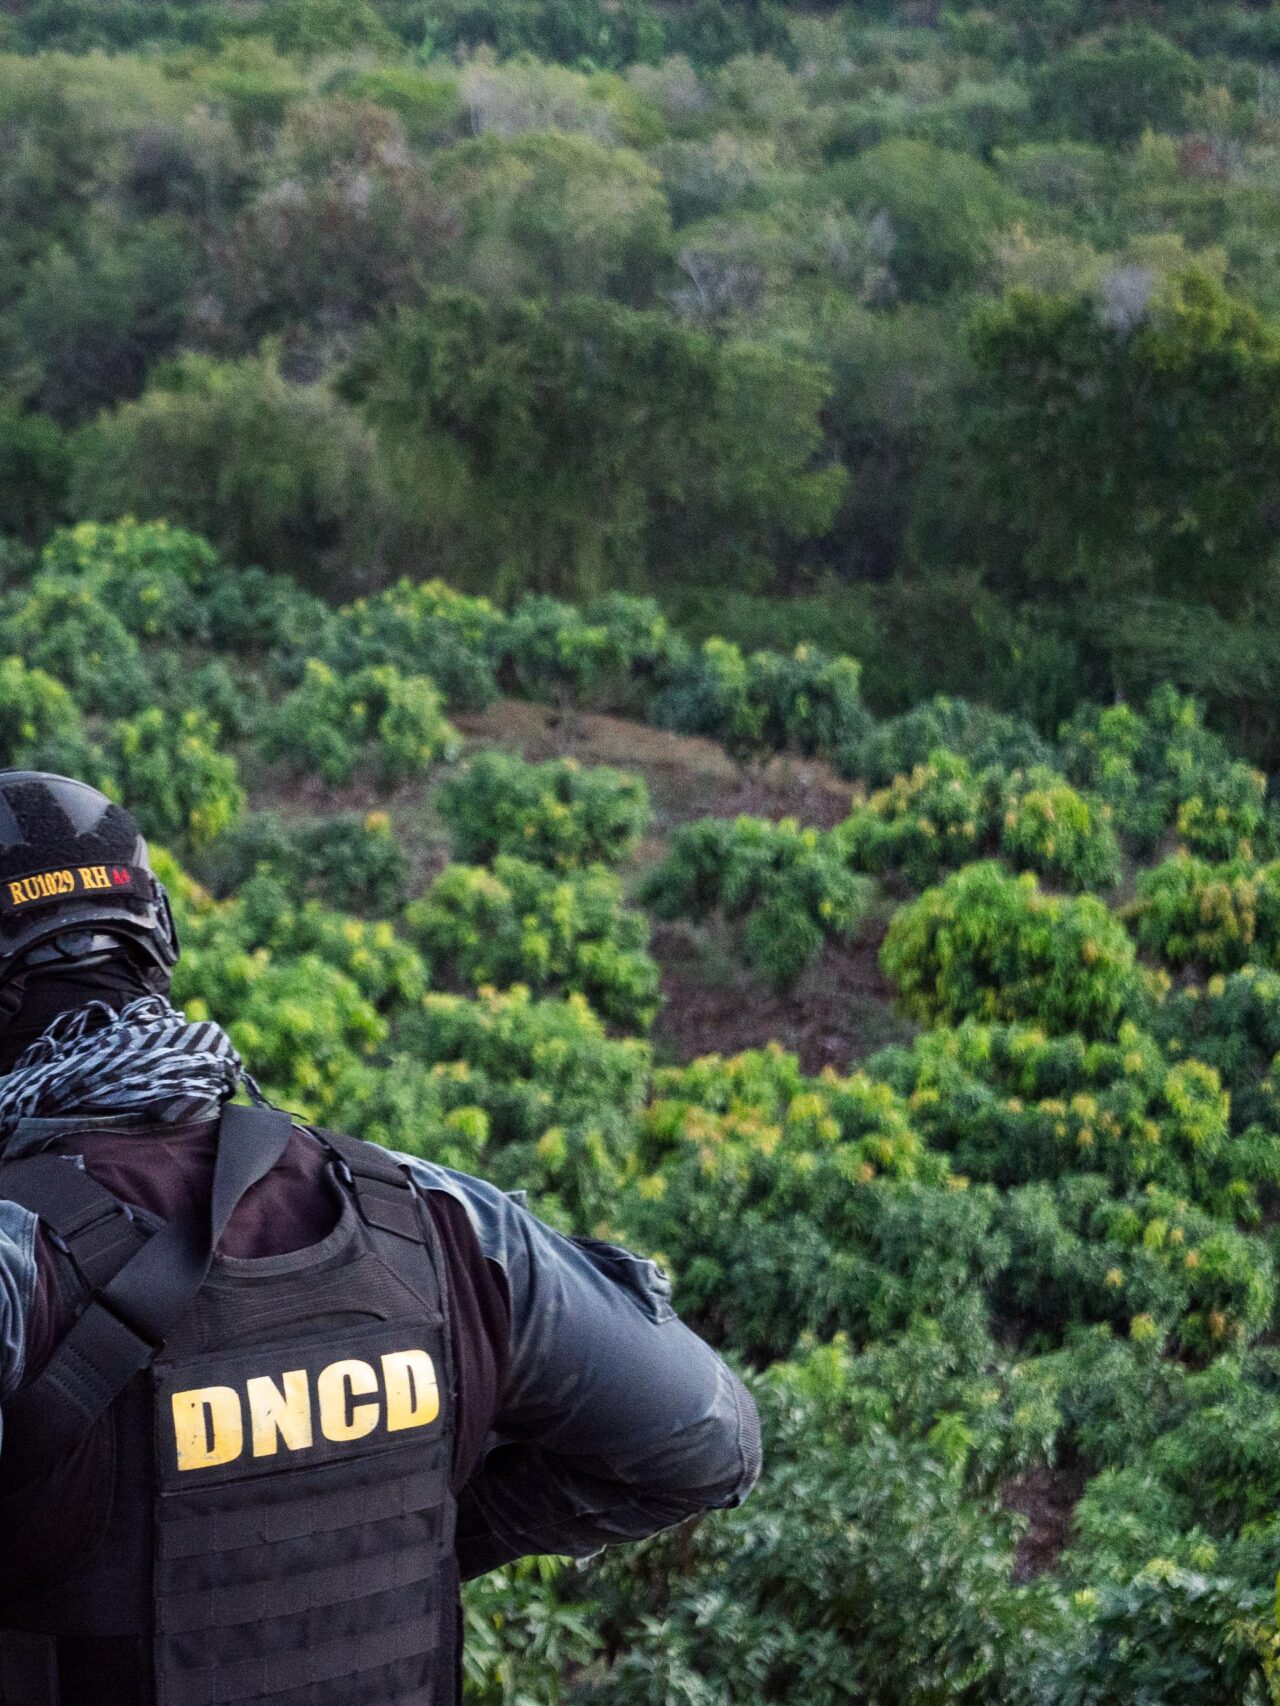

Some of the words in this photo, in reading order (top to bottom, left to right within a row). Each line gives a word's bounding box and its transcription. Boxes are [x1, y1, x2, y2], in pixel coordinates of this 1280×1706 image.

[7, 869, 75, 905] RU1029
[77, 866, 112, 889] RH
[172, 1350, 440, 1471] DNCD
